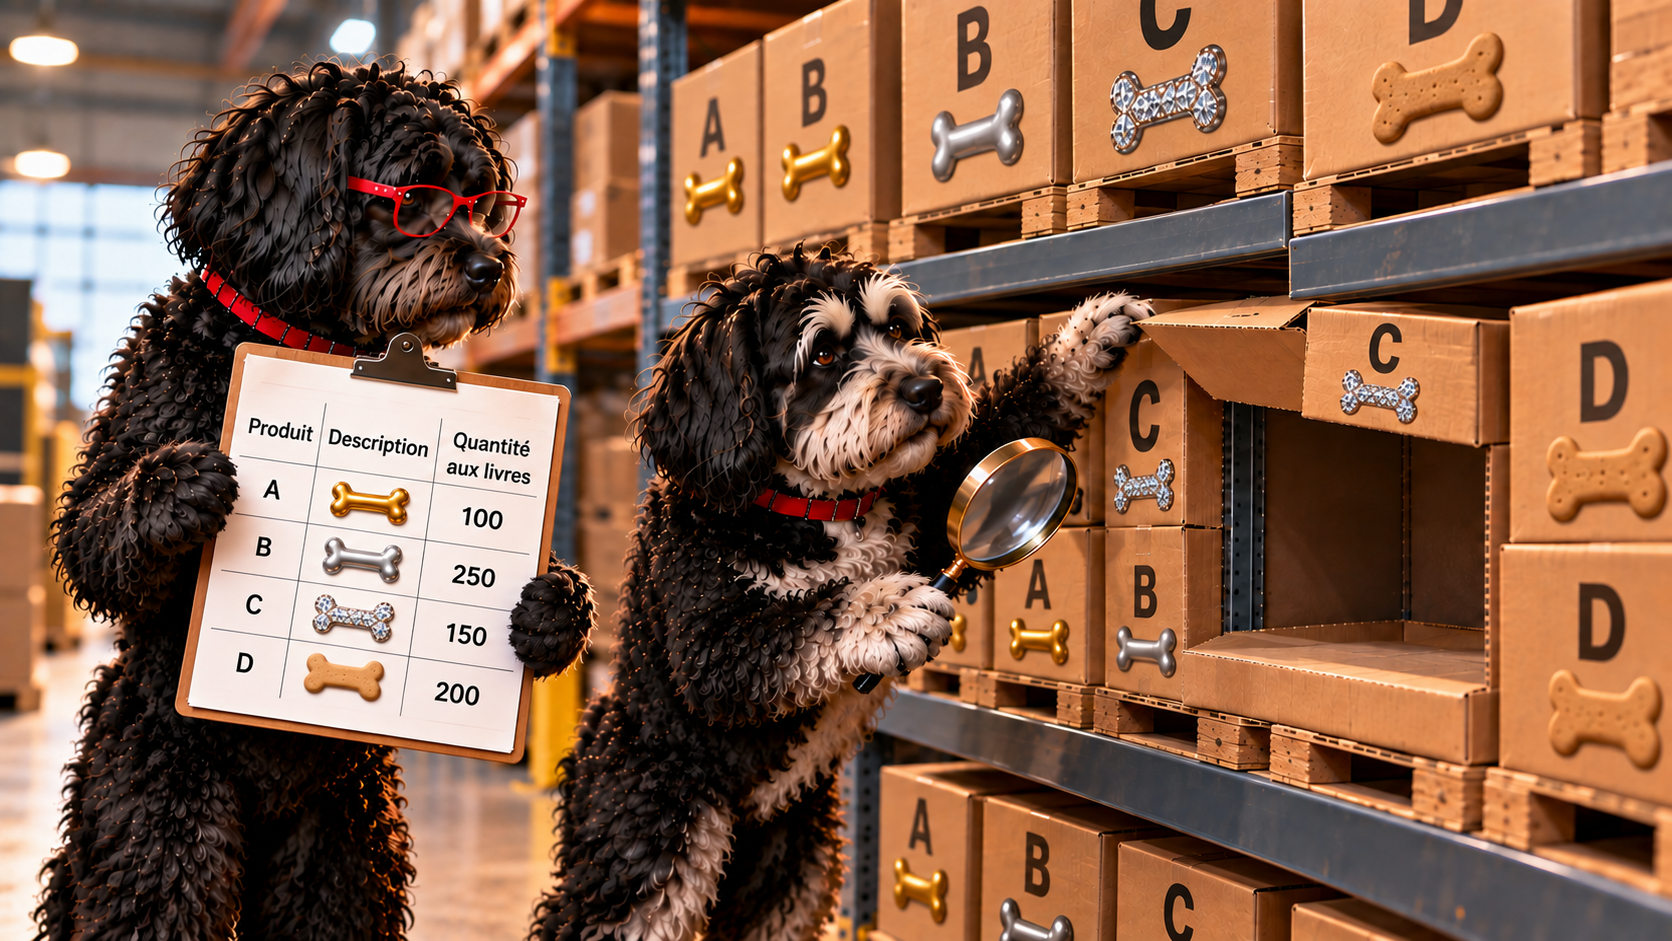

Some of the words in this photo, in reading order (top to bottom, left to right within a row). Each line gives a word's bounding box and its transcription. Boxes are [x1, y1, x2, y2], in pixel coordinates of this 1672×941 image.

[957, 6, 992, 92] B
[801, 58, 827, 127] B
[700, 98, 725, 158] A
[1368, 322, 1403, 374] C
[1580, 339, 1630, 423] D
[248, 417, 314, 443] Produit
[1128, 379, 1161, 453] C
[328, 428, 430, 459] Description
[452, 431, 531, 458] Quantité
[262, 479, 281, 501] A
[446, 460, 480, 479] aux
[483, 462, 532, 486] livres
[461, 506, 504, 530] 100
[255, 536, 272, 557] B
[451, 564, 497, 588] 250
[1024, 558, 1052, 610] A
[1133, 565, 1158, 619] B
[245, 593, 263, 615] C
[1578, 582, 1627, 663] D
[445, 623, 488, 647] 150
[235, 651, 254, 674] D
[434, 681, 481, 706] 200
[908, 797, 933, 856] A
[1024, 830, 1052, 899] B
[1163, 882, 1195, 941] C
